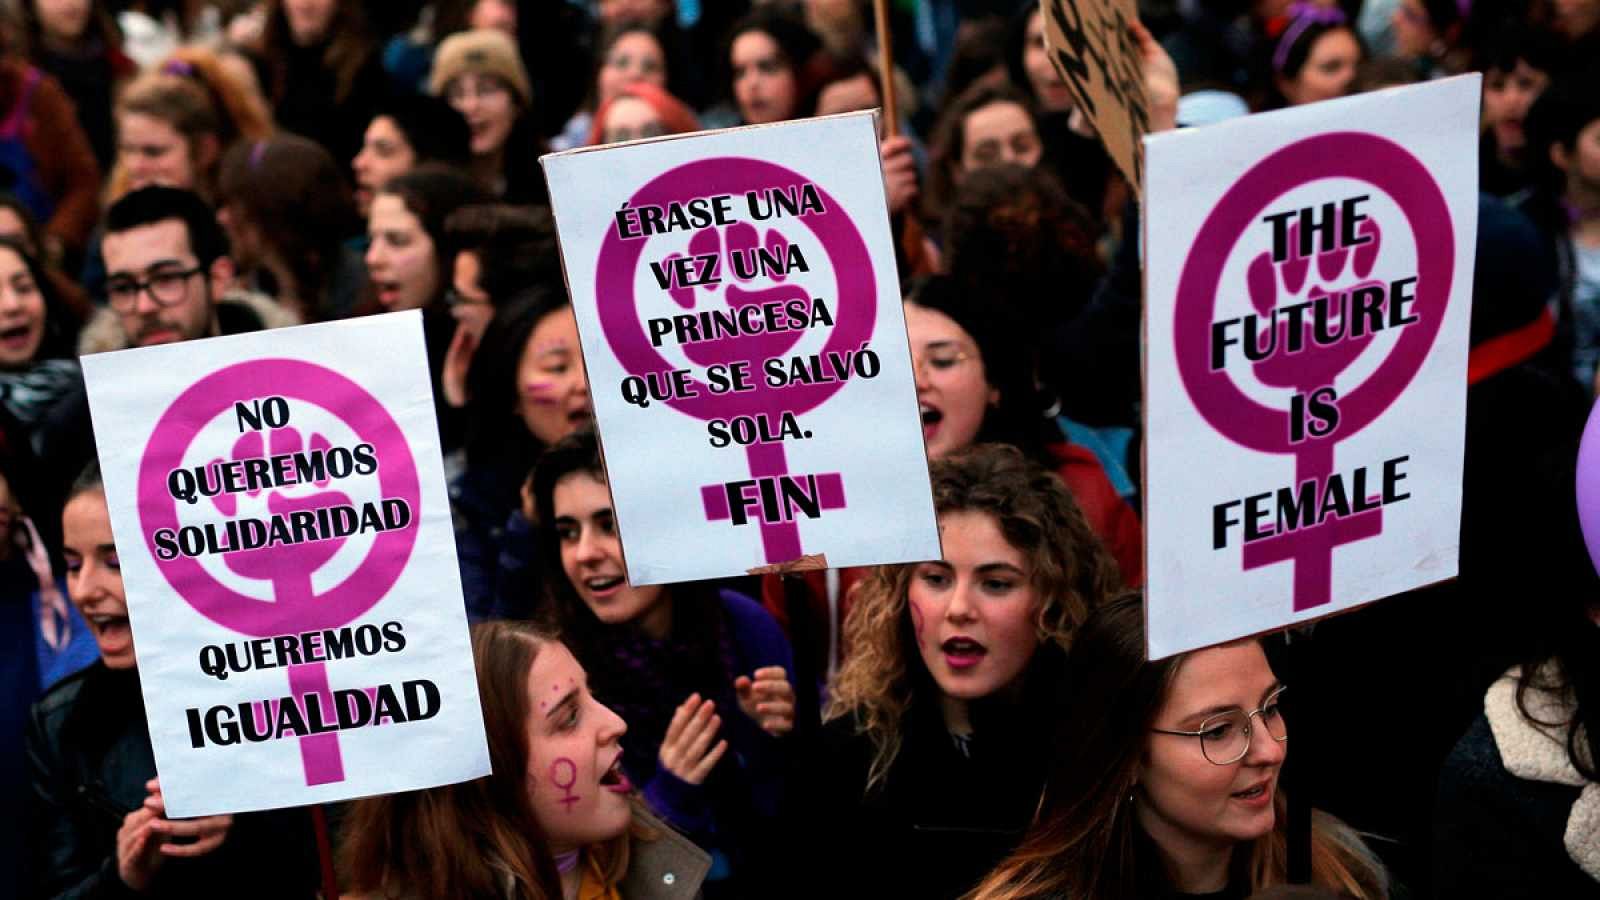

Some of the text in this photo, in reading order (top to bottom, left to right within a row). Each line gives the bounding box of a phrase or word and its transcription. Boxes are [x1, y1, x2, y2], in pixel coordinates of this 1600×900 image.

[615, 184, 825, 239] ÉRASE UNA
[1263, 195, 1372, 263] THE
[650, 243, 809, 290] VEZ UNA
[647, 298, 834, 347] PRINCESA
[1211, 276, 1418, 370] FUTURE
[620, 342, 881, 409] QUE SE SALVÓ
[235, 396, 290, 433] NO
[707, 412, 813, 448] SOLA.
[1290, 387, 1339, 442] IS
[168, 443, 377, 505] QUEREMOS
[725, 474, 821, 526] FIN
[1213, 455, 1411, 550] FEMALE
[154, 499, 410, 560] SOLIDARIDAD
[199, 621, 406, 681] QUEREMOS
[186, 679, 441, 749] IGUALDAD
